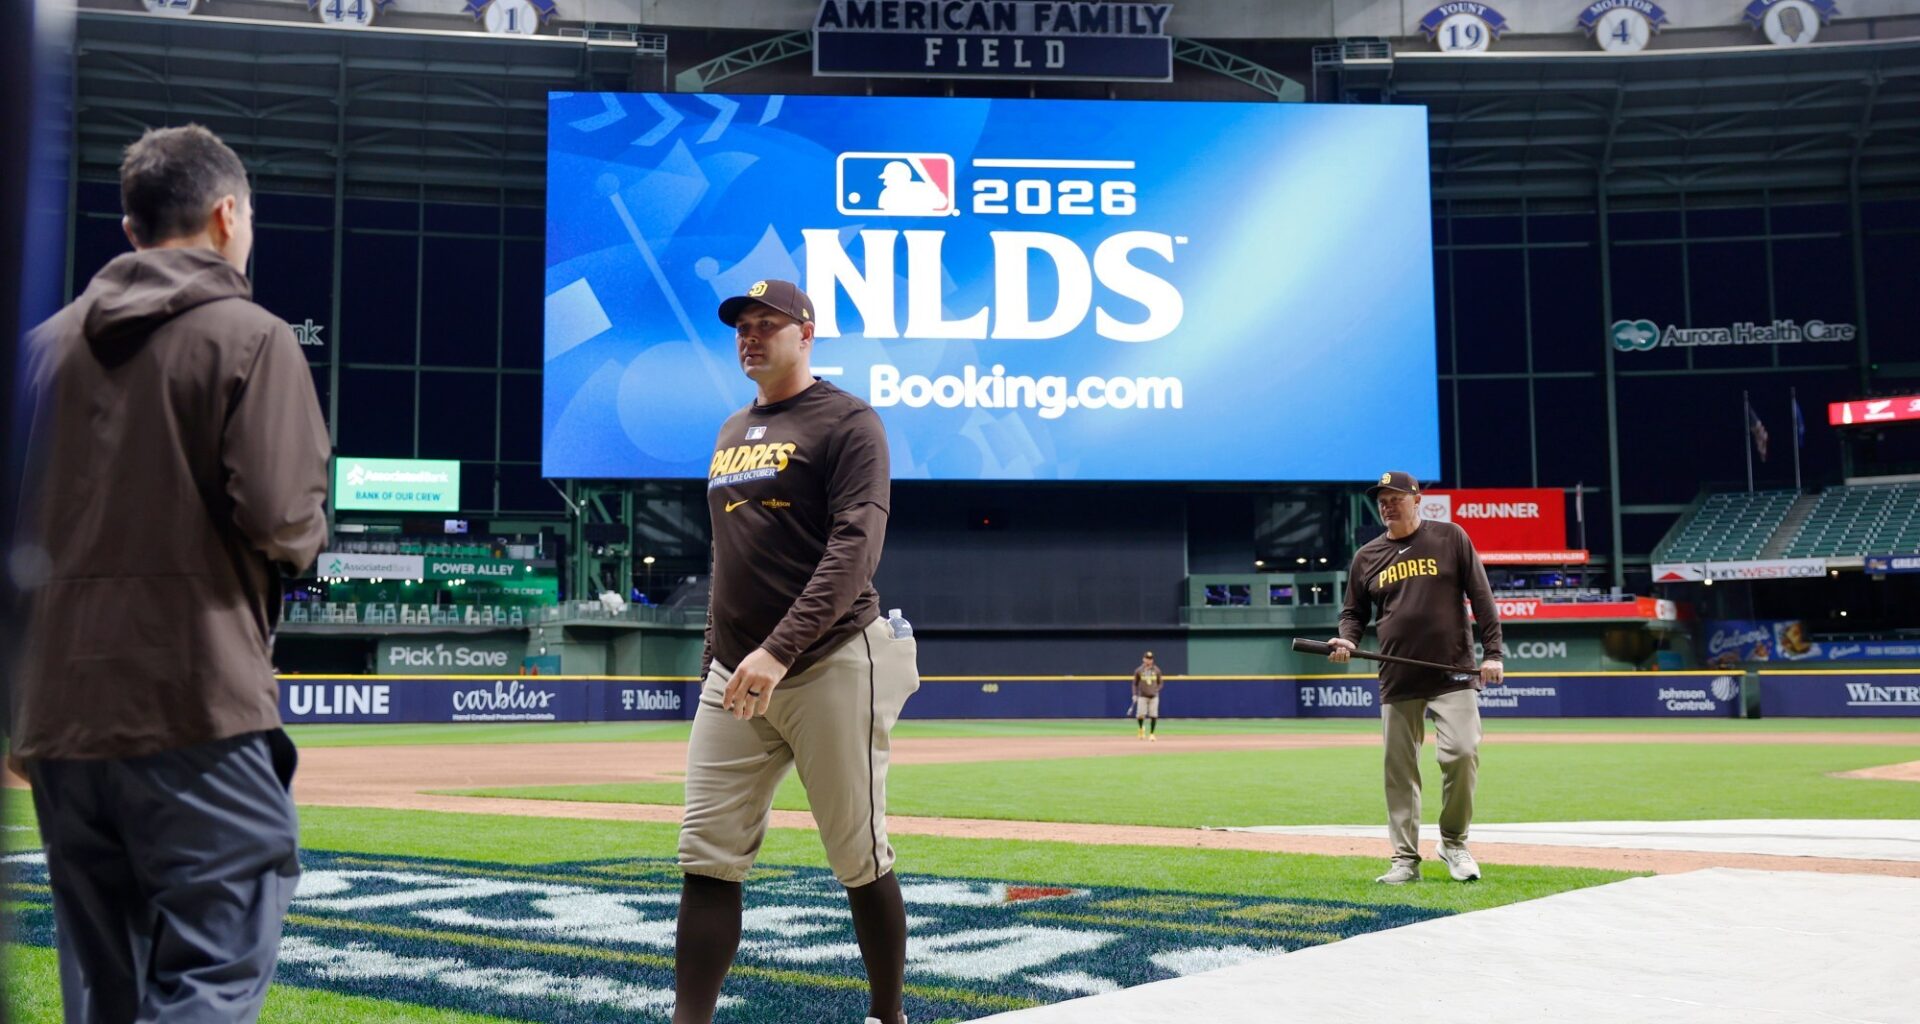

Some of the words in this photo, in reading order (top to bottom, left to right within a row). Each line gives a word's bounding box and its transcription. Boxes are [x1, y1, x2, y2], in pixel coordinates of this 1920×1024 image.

[504, 5, 522, 34] 1
[818, 0, 1020, 33] AMERICAN
[1034, 3, 1168, 35] FAMILY
[1439, 4, 1487, 17] YOUNT
[1445, 23, 1483, 49] 19
[1612, 18, 1630, 45] 4
[925, 38, 1065, 69] FIELD
[972, 179, 1137, 216] 2026
[1659, 324, 1732, 347] Aurora
[1732, 320, 1802, 344] Health
[1803, 319, 1857, 342] Care
[869, 364, 1184, 419] Booking.com
[709, 442, 797, 480] PADRES
[355, 490, 380, 500] BANK
[381, 491, 393, 501] OF
[395, 492, 414, 501] OUR
[416, 492, 441, 502] CREW
[1456, 502, 1540, 519] 4RUNNER
[432, 562, 475, 575] POWER
[478, 564, 515, 576] ALLEY
[1378, 558, 1438, 589] PADRES
[1494, 602, 1538, 617] TORY
[455, 647, 508, 667] Save
[289, 685, 390, 715] ULINE
[452, 680, 556, 711] carbliss
[637, 690, 681, 710] Mobile
[1318, 686, 1373, 707] Mobile
[1658, 688, 1706, 700] Johnson
[1846, 683, 1920, 701] WINTR
[1666, 700, 1716, 711] Controls
